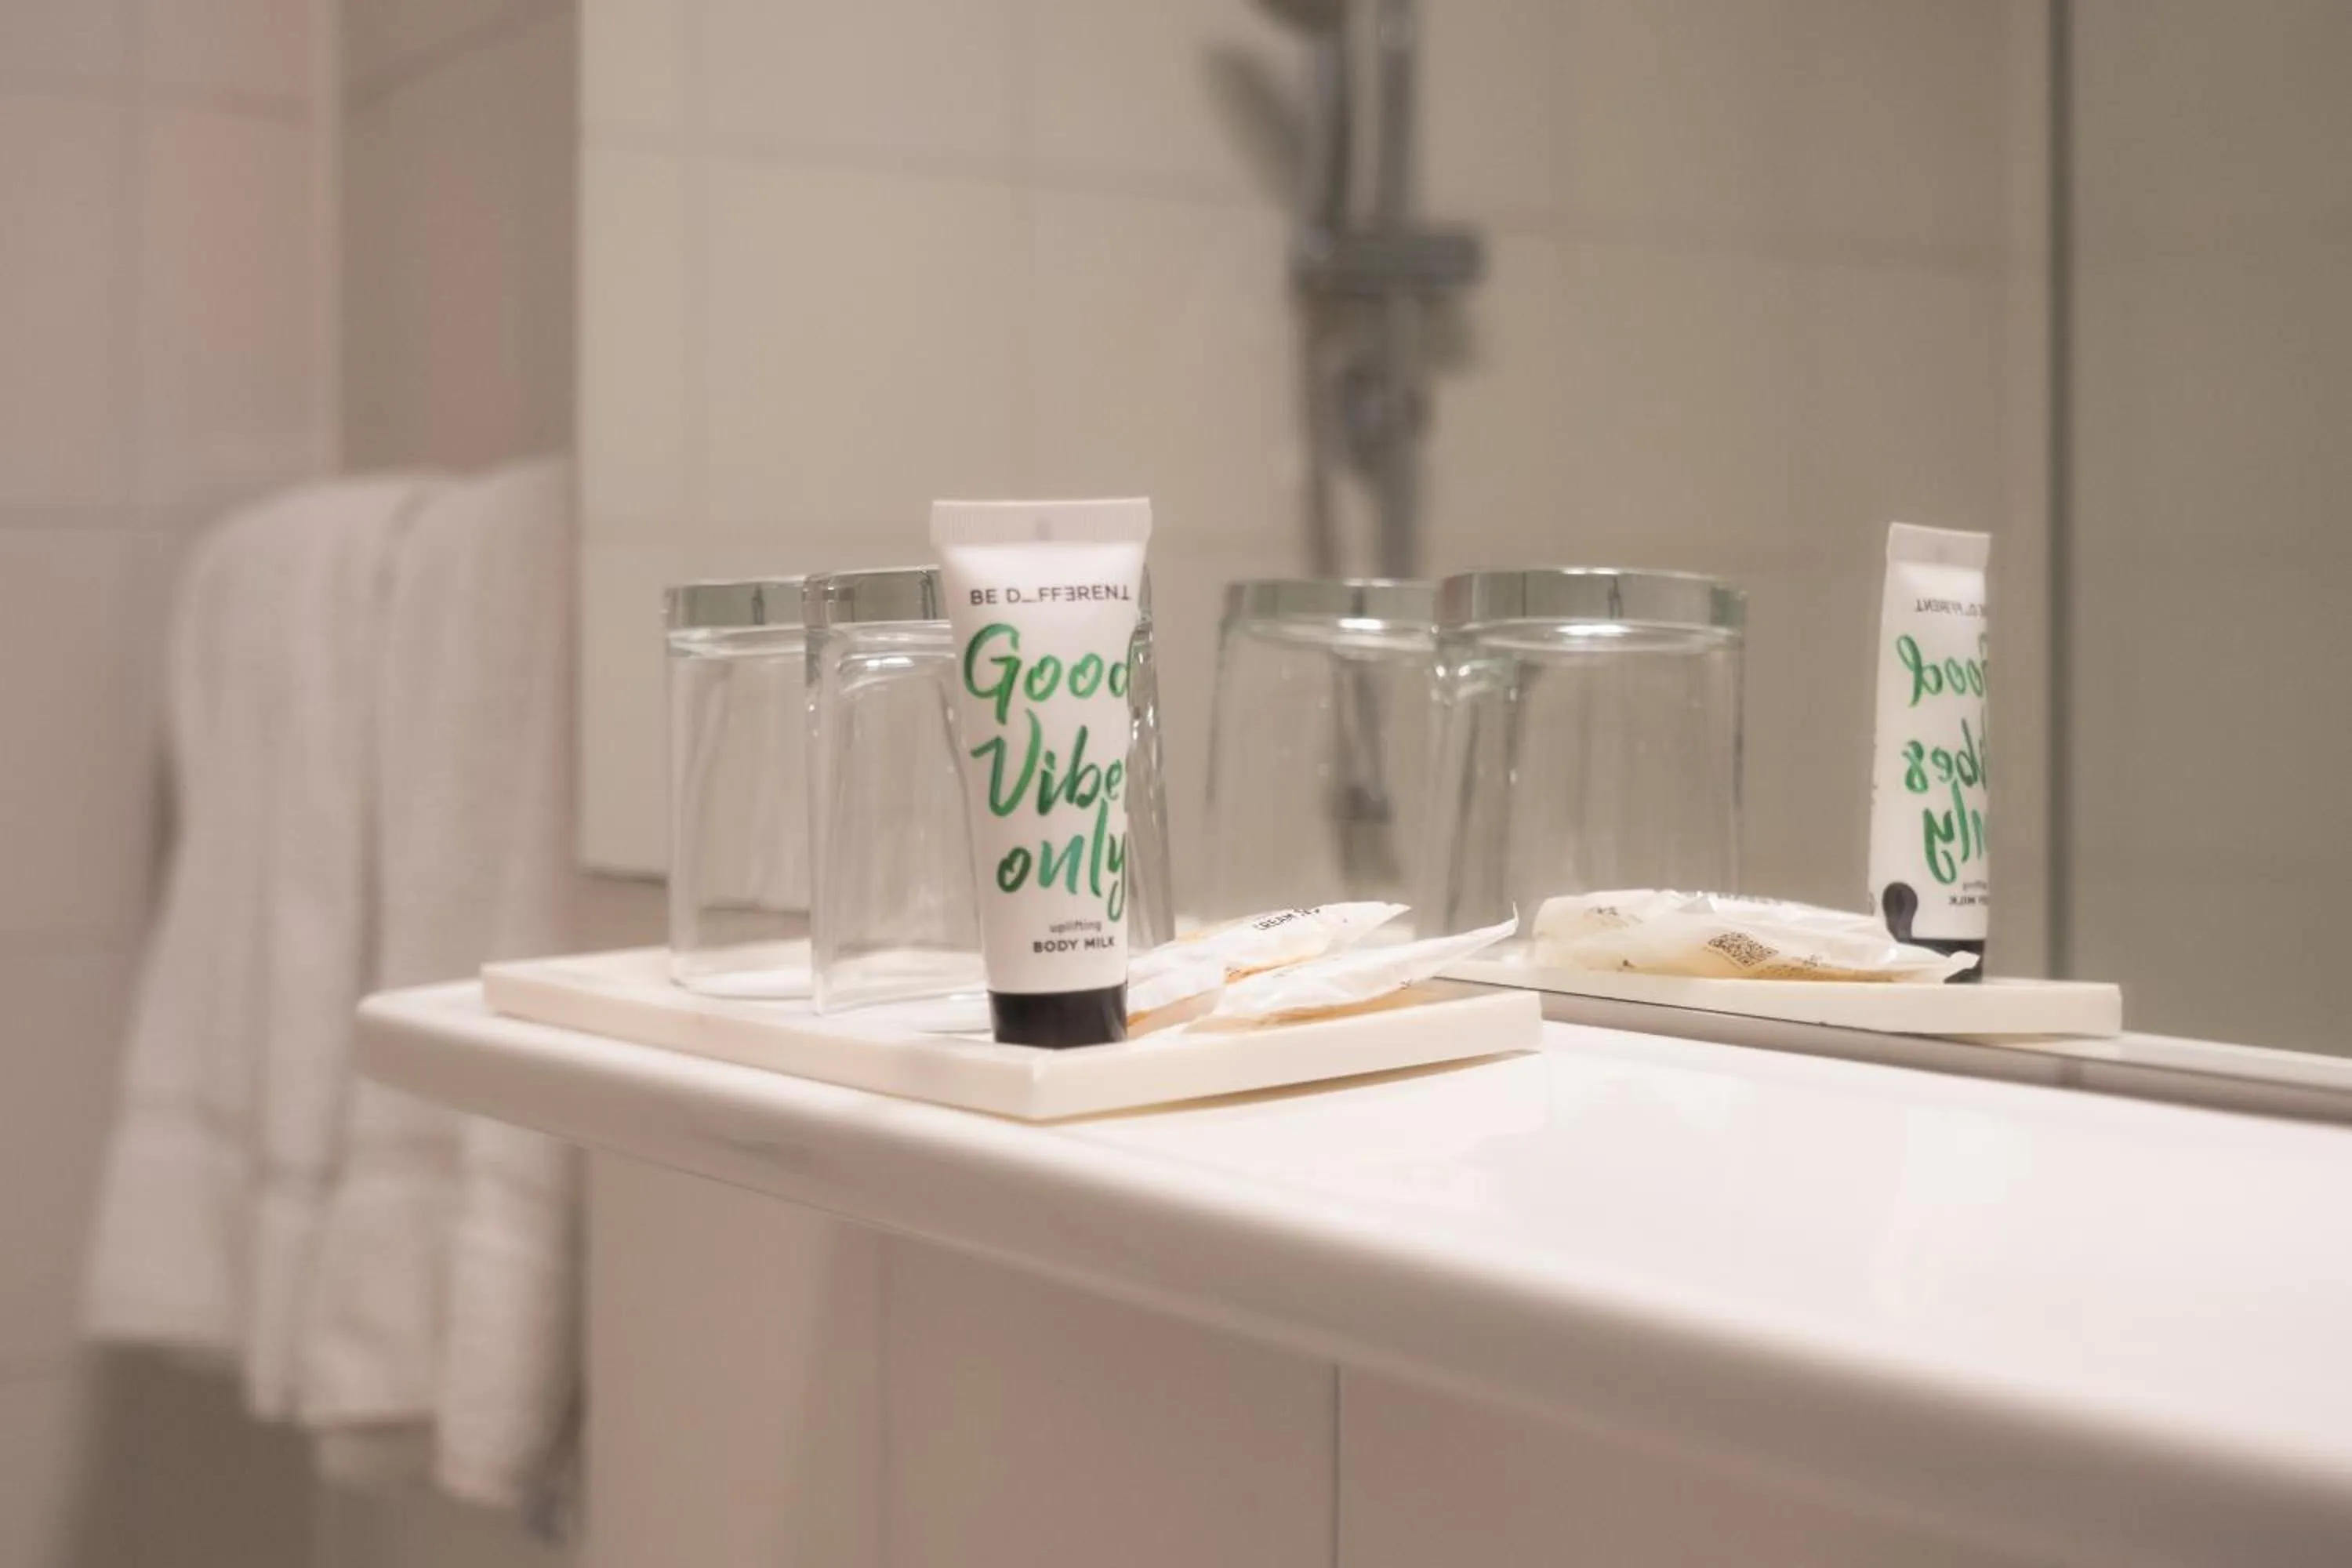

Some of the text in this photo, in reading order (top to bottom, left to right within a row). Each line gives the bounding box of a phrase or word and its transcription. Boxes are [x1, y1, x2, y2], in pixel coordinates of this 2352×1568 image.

[969, 588, 998, 606] BE
[996, 798, 1127, 922] only
[1033, 936, 1115, 953] BODY MILK
